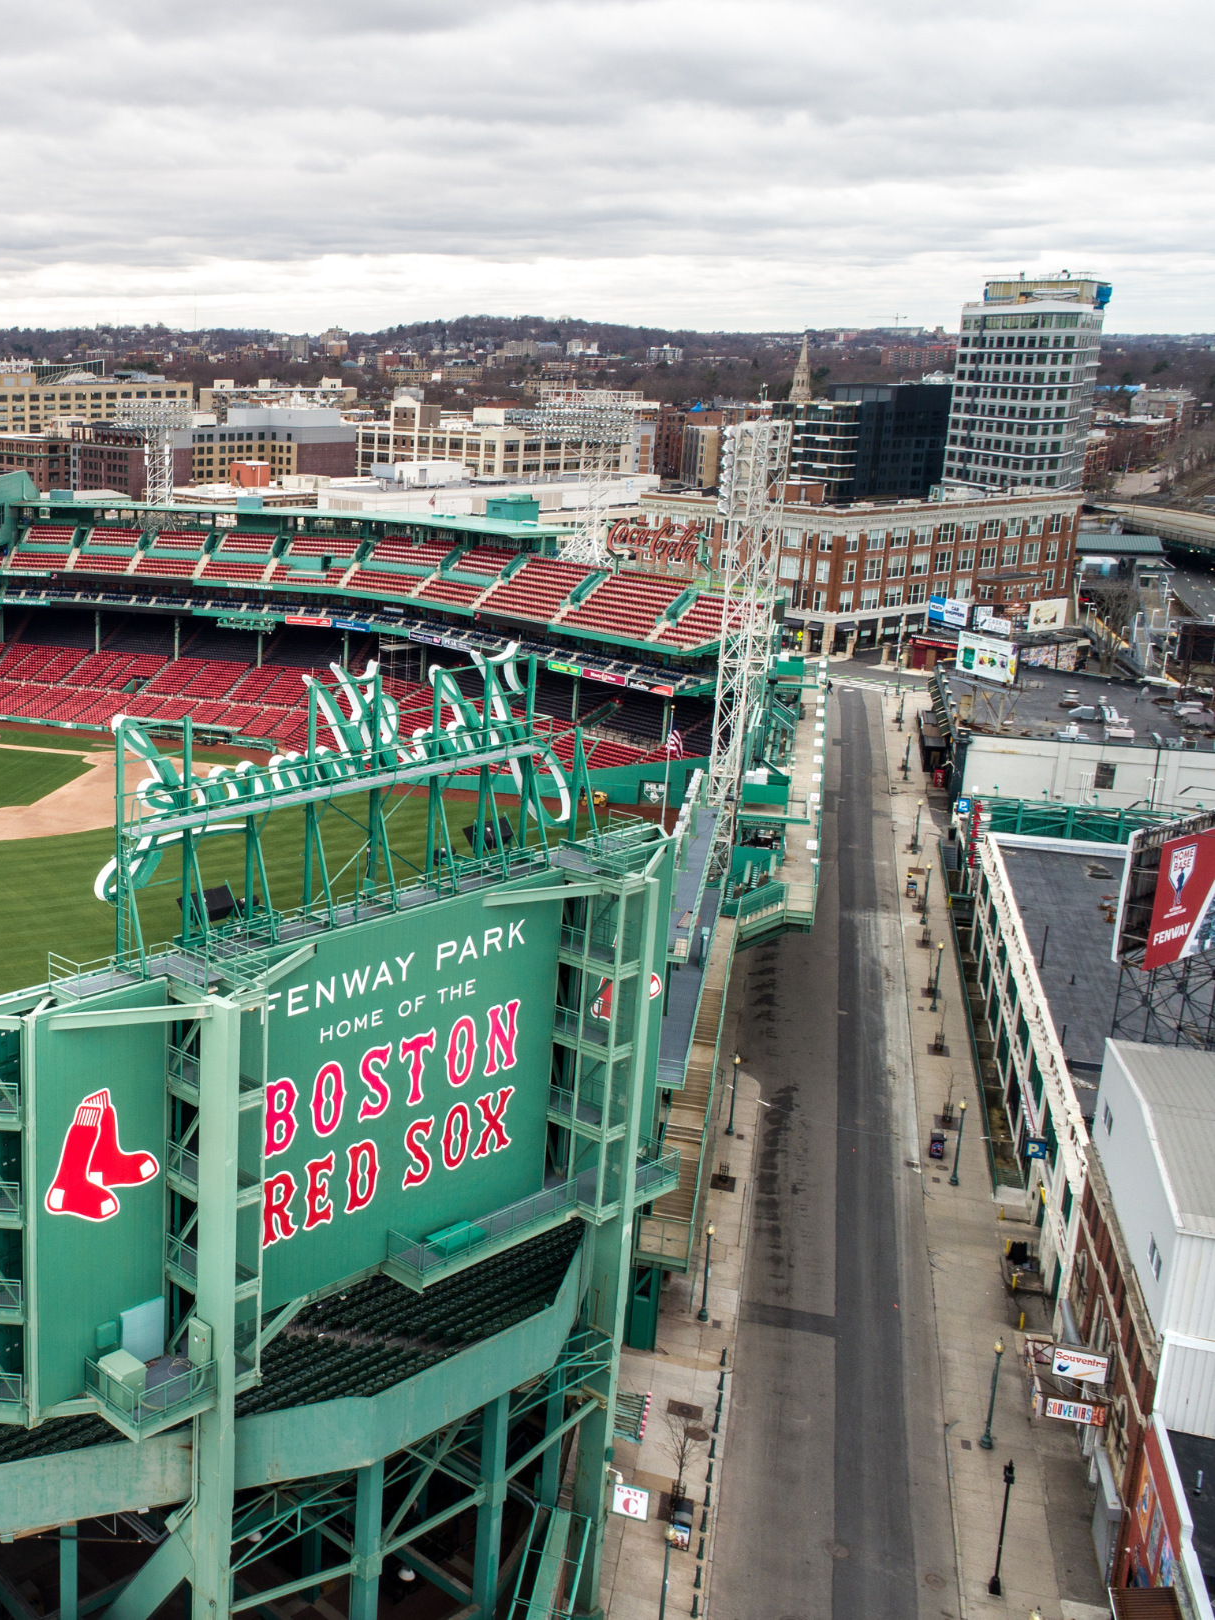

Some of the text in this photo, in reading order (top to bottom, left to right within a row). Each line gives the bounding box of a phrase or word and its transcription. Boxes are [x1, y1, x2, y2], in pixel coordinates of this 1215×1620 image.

[607, 518, 704, 560] Coca-Cola
[645, 783, 665, 791] MLB
[958, 801, 968, 809] P
[1173, 848, 1194, 863] HOME
[1173, 859, 1191, 872] BASE
[1152, 922, 1191, 946] FENWAY
[260, 919, 525, 1026] FENWAY PARK
[320, 979, 476, 1043] HOME OF THE
[265, 999, 521, 1160] BOSTON
[1027, 1143, 1039, 1156] P
[263, 1085, 516, 1250] RED SOX
[1055, 1351, 1107, 1369] Souvenirs
[1047, 1401, 1092, 1421] SOUVENIRS
[616, 1487, 646, 1499] GATE
[622, 1497, 639, 1515] C
